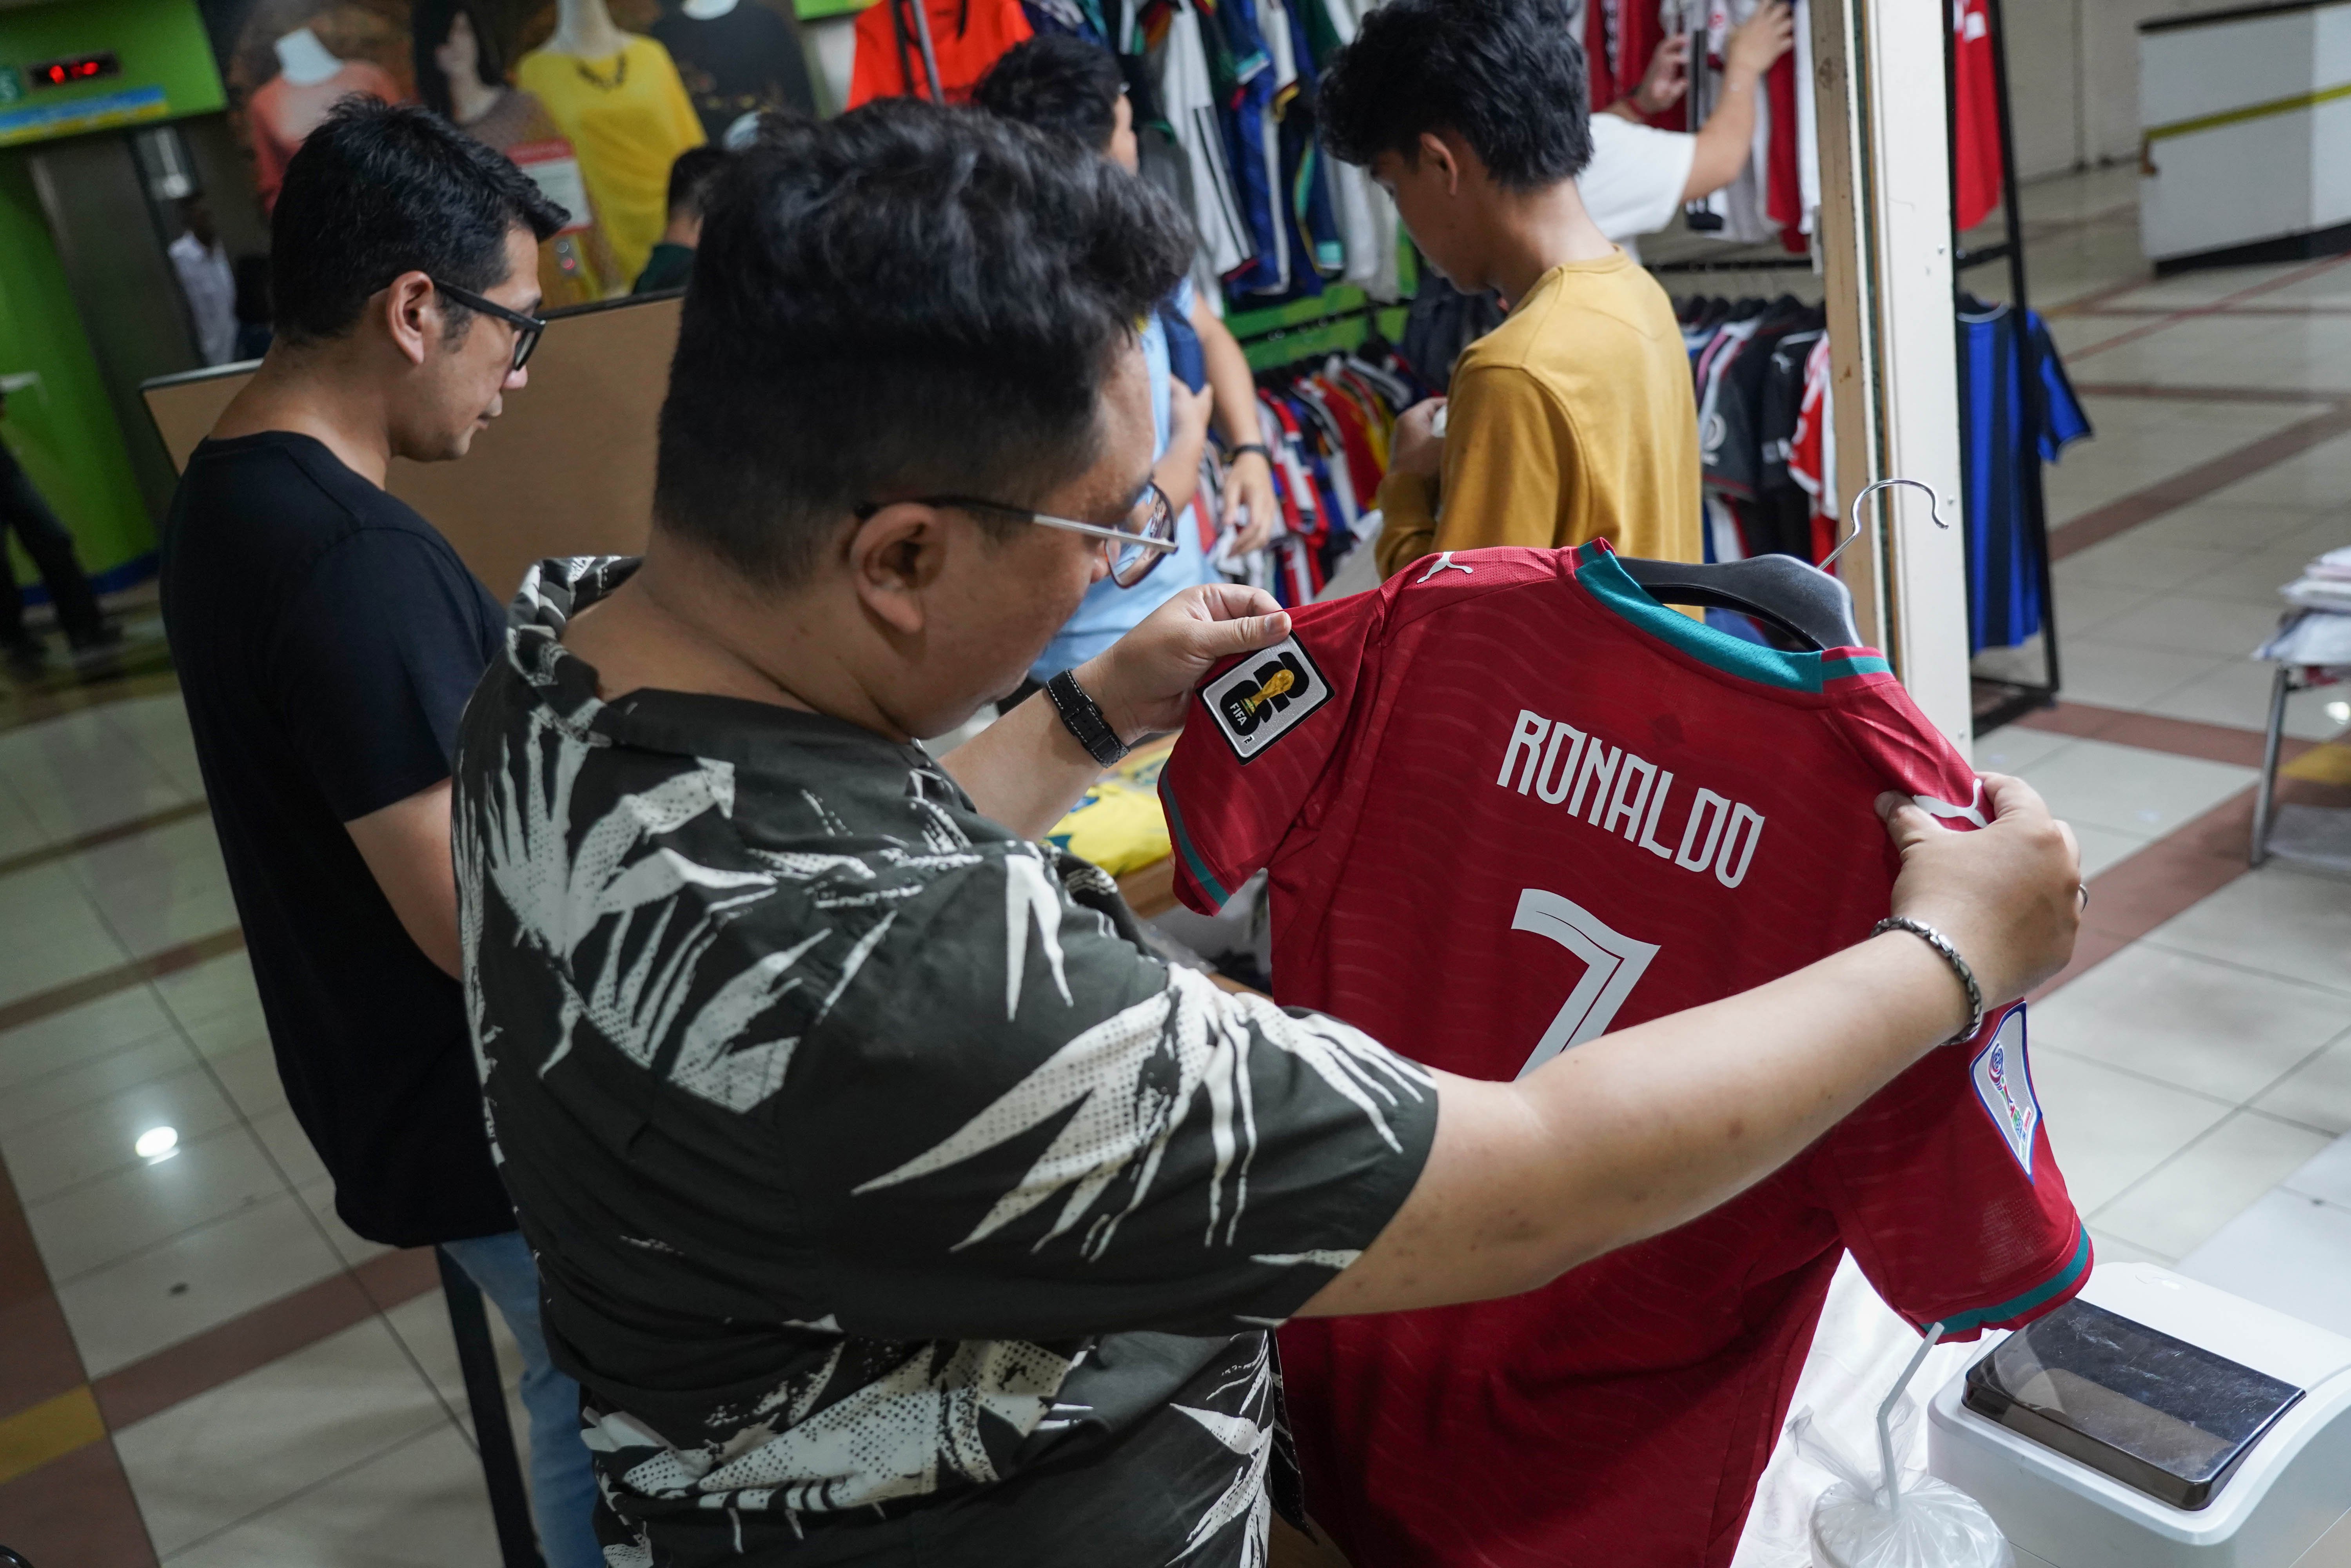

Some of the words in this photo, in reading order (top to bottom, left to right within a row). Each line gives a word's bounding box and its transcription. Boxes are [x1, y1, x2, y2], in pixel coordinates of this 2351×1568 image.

[1229, 702, 1247, 726] FIFA
[1496, 709, 1765, 888] RONALDO
[1511, 888, 1661, 1081] 7
